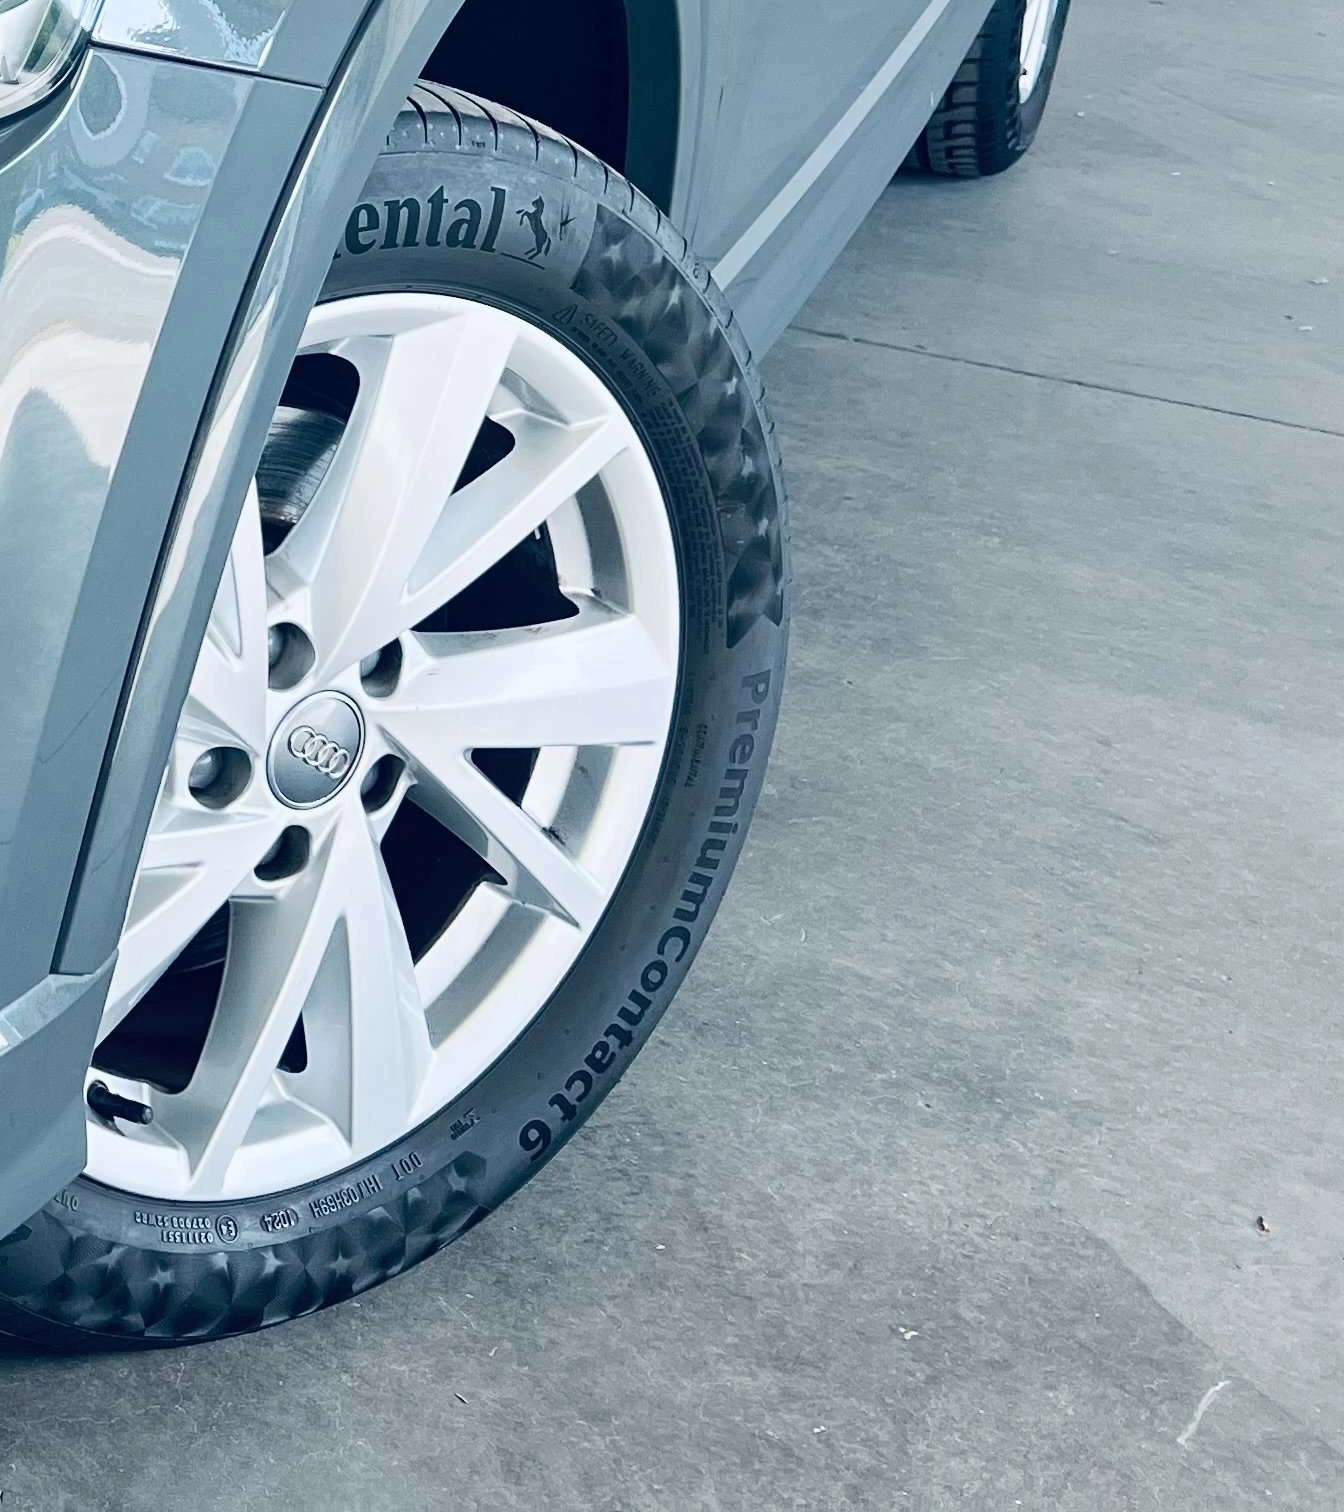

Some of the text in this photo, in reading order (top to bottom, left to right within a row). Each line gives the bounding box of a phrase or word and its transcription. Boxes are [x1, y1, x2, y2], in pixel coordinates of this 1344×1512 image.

[333, 185, 507, 261] ental
[549, 668, 773, 1125] PremiumContact
[518, 1117, 554, 1162] 6
